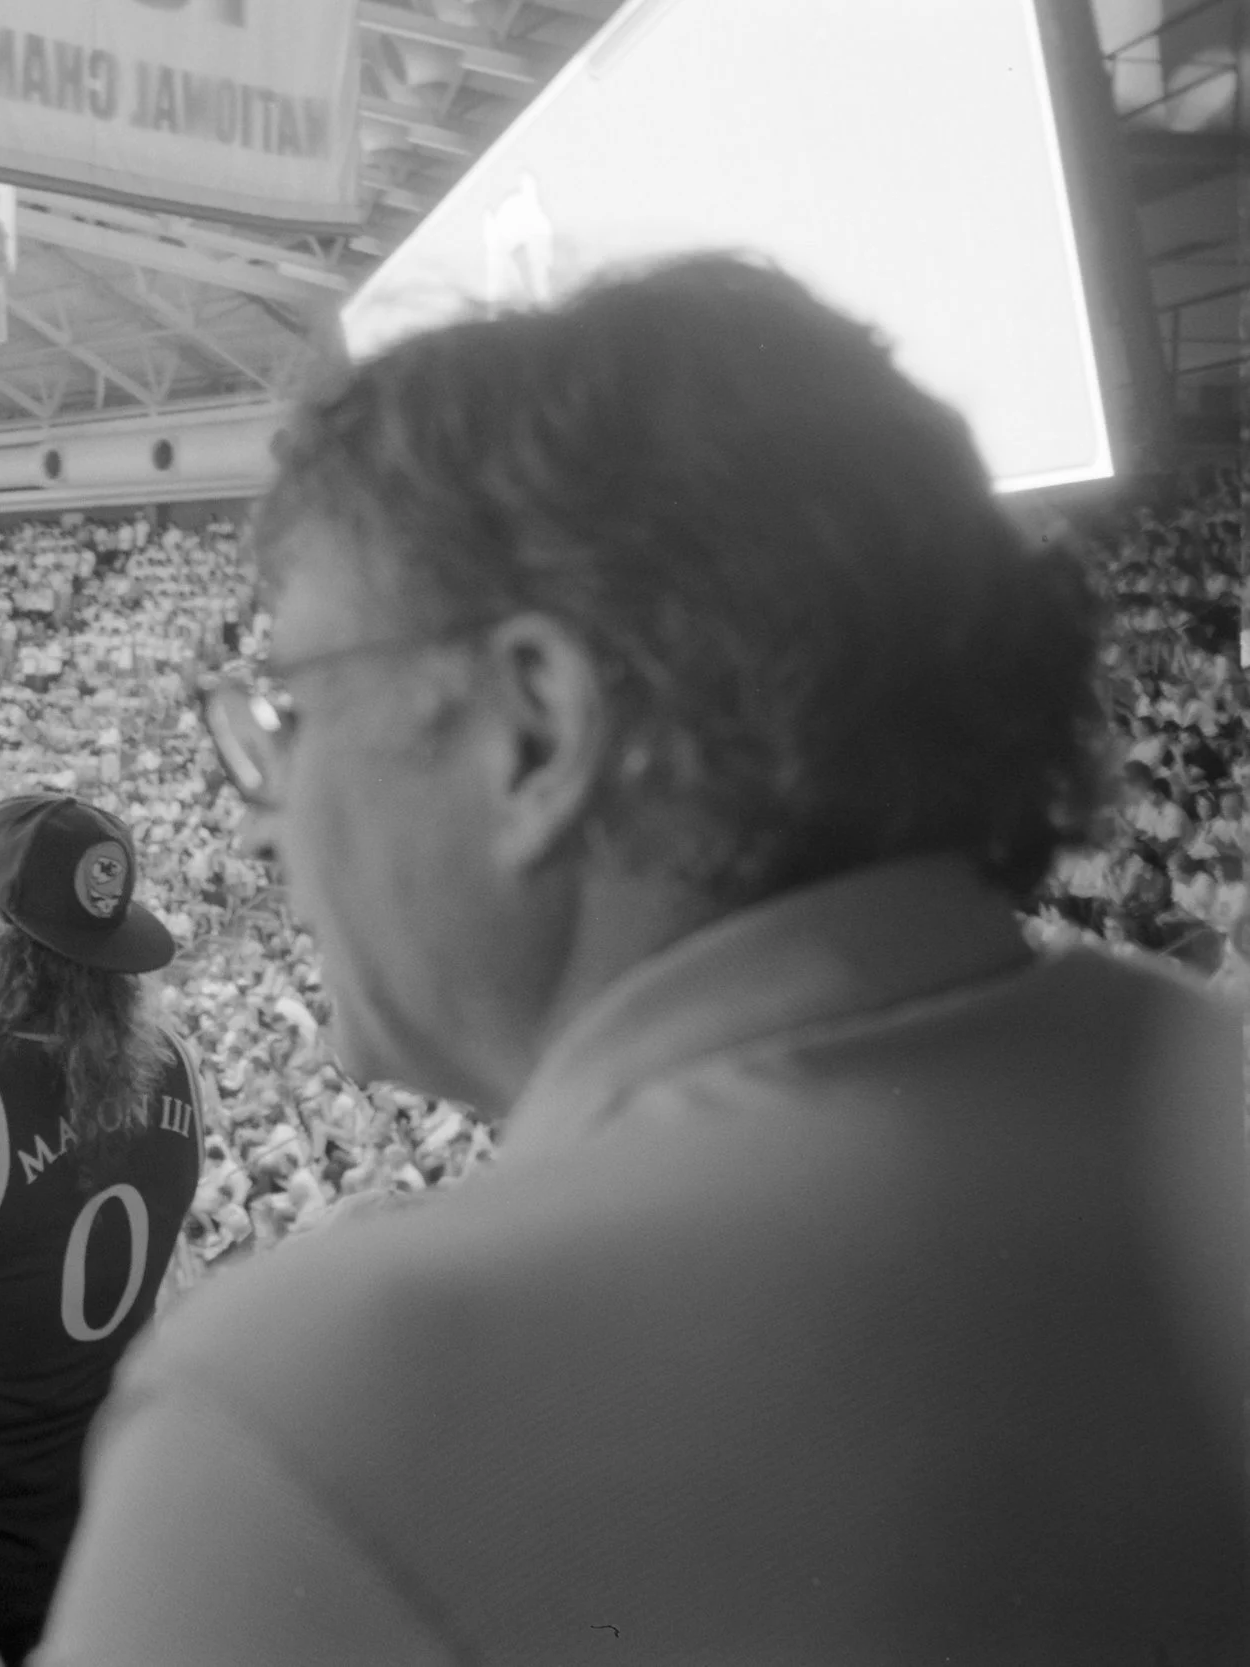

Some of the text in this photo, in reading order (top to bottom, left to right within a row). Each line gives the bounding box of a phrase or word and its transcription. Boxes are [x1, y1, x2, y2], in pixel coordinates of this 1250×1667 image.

[17, 1094, 192, 1184] MAON III
[61, 1183, 149, 1342] 0
